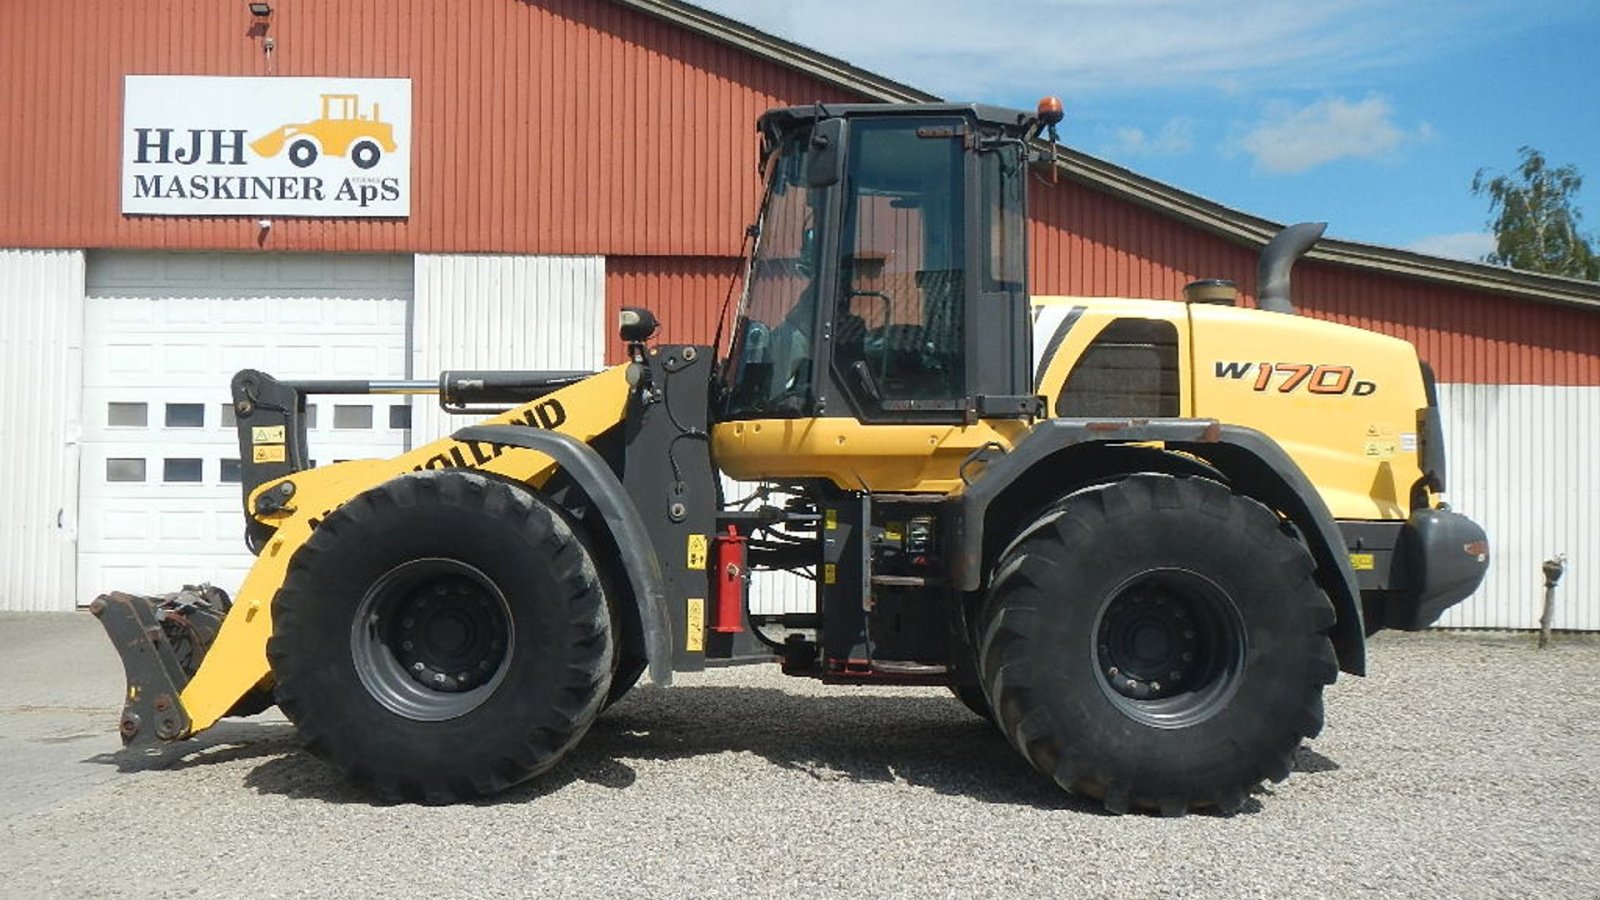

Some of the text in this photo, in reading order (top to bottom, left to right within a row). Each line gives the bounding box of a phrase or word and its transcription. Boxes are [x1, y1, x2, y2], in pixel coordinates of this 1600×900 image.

[133, 128, 248, 165] HJH
[133, 174, 400, 207] MASKINER ApS
